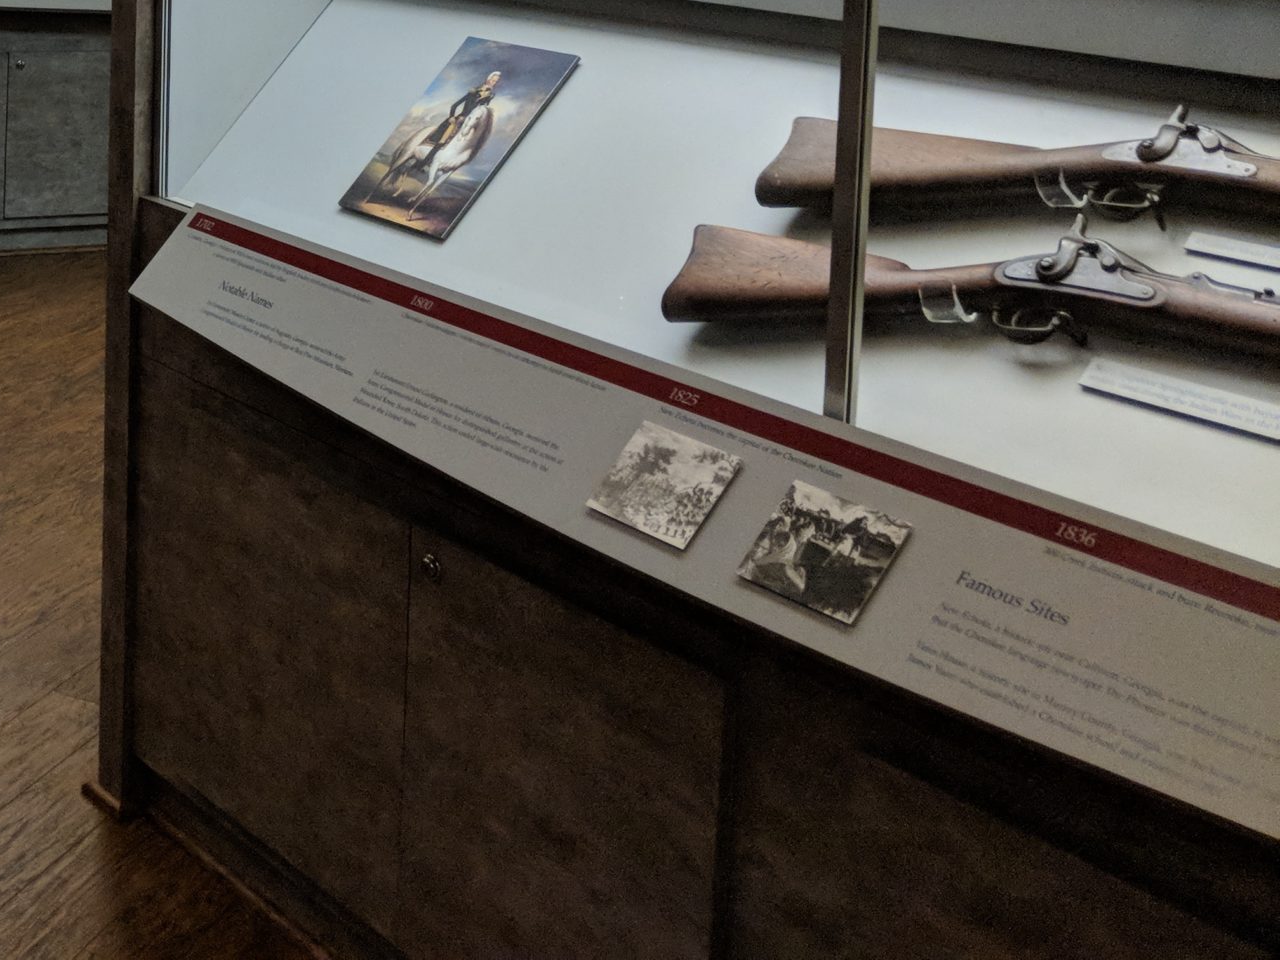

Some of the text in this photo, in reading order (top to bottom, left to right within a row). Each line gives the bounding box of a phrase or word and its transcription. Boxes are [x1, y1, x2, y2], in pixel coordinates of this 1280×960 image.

[219, 280, 248, 301] Notable
[247, 291, 275, 309] Names
[410, 295, 434, 311] 1800
[669, 387, 700, 407] 1825
[1055, 521, 1098, 548] 1836
[956, 570, 1070, 626] Famous Sites
